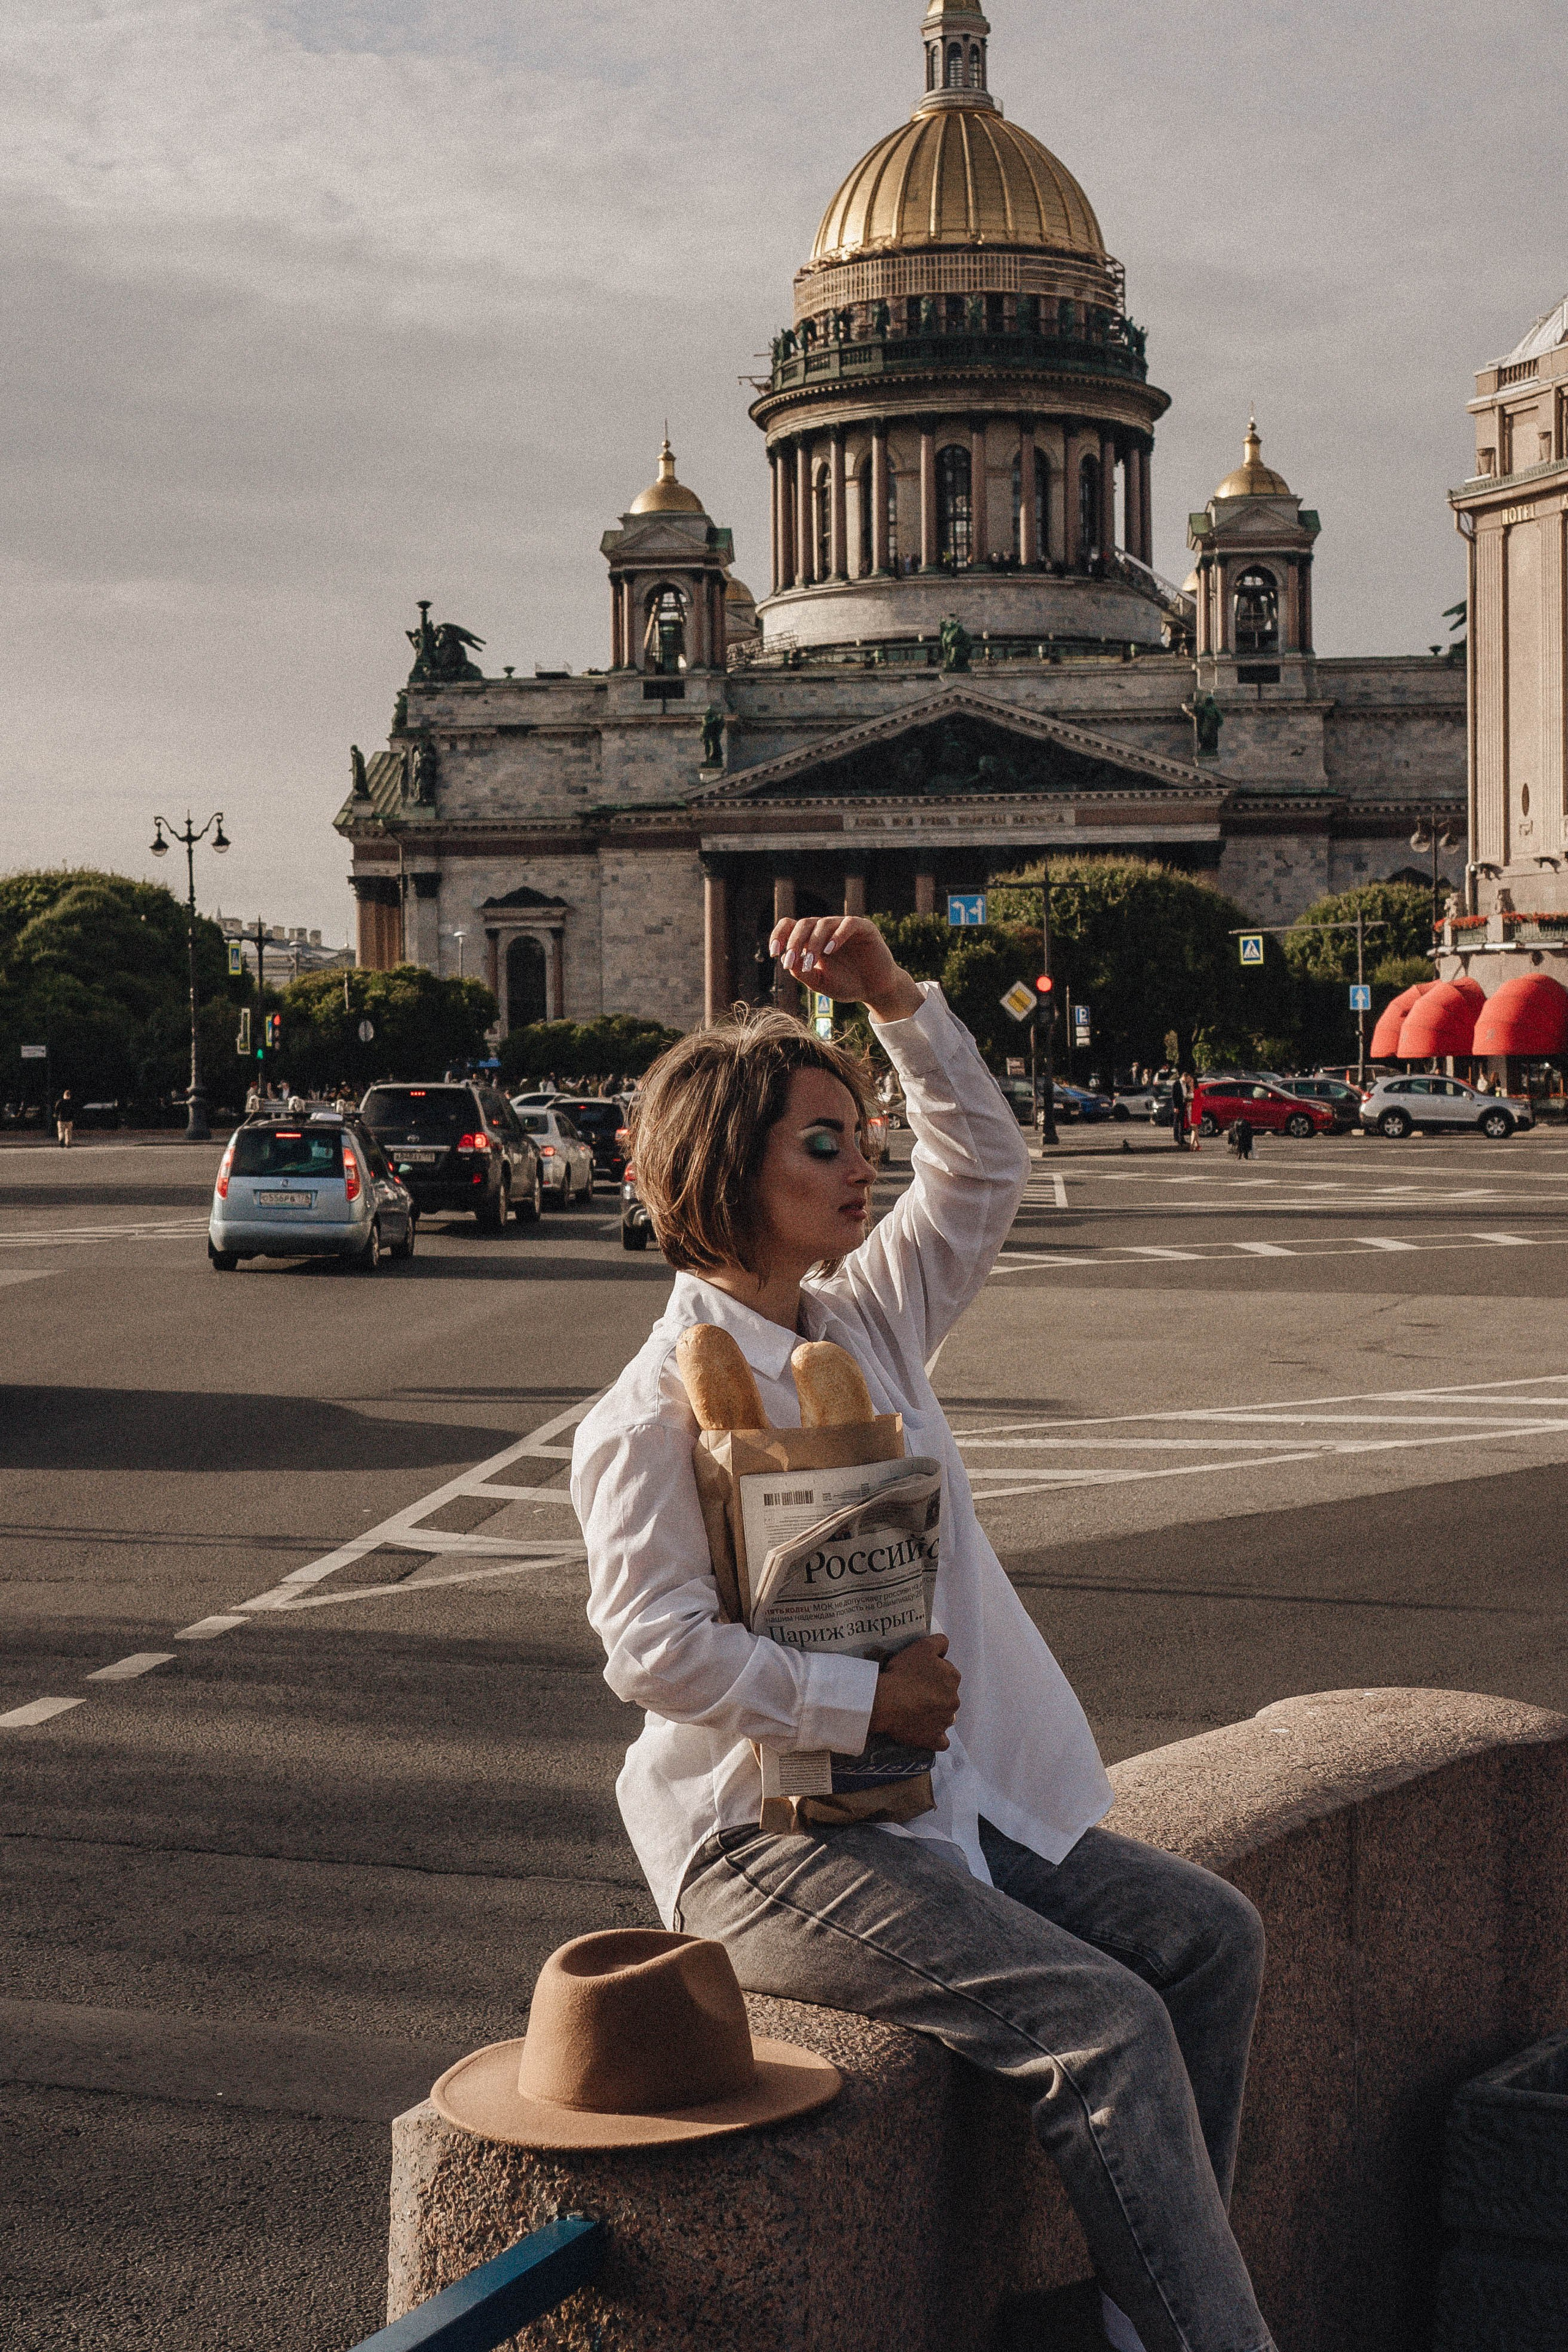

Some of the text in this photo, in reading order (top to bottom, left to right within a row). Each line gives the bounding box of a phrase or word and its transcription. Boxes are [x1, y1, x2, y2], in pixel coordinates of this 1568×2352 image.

[813, 1602, 833, 1612] МОК
[834, 1600, 843, 1609] не
[843, 1594, 882, 1607] допускает
[883, 1586, 911, 1600] россиян
[794, 1612, 835, 1621] надеждам
[837, 1605, 864, 1616] попасть
[767, 1625, 845, 1648] Париж
